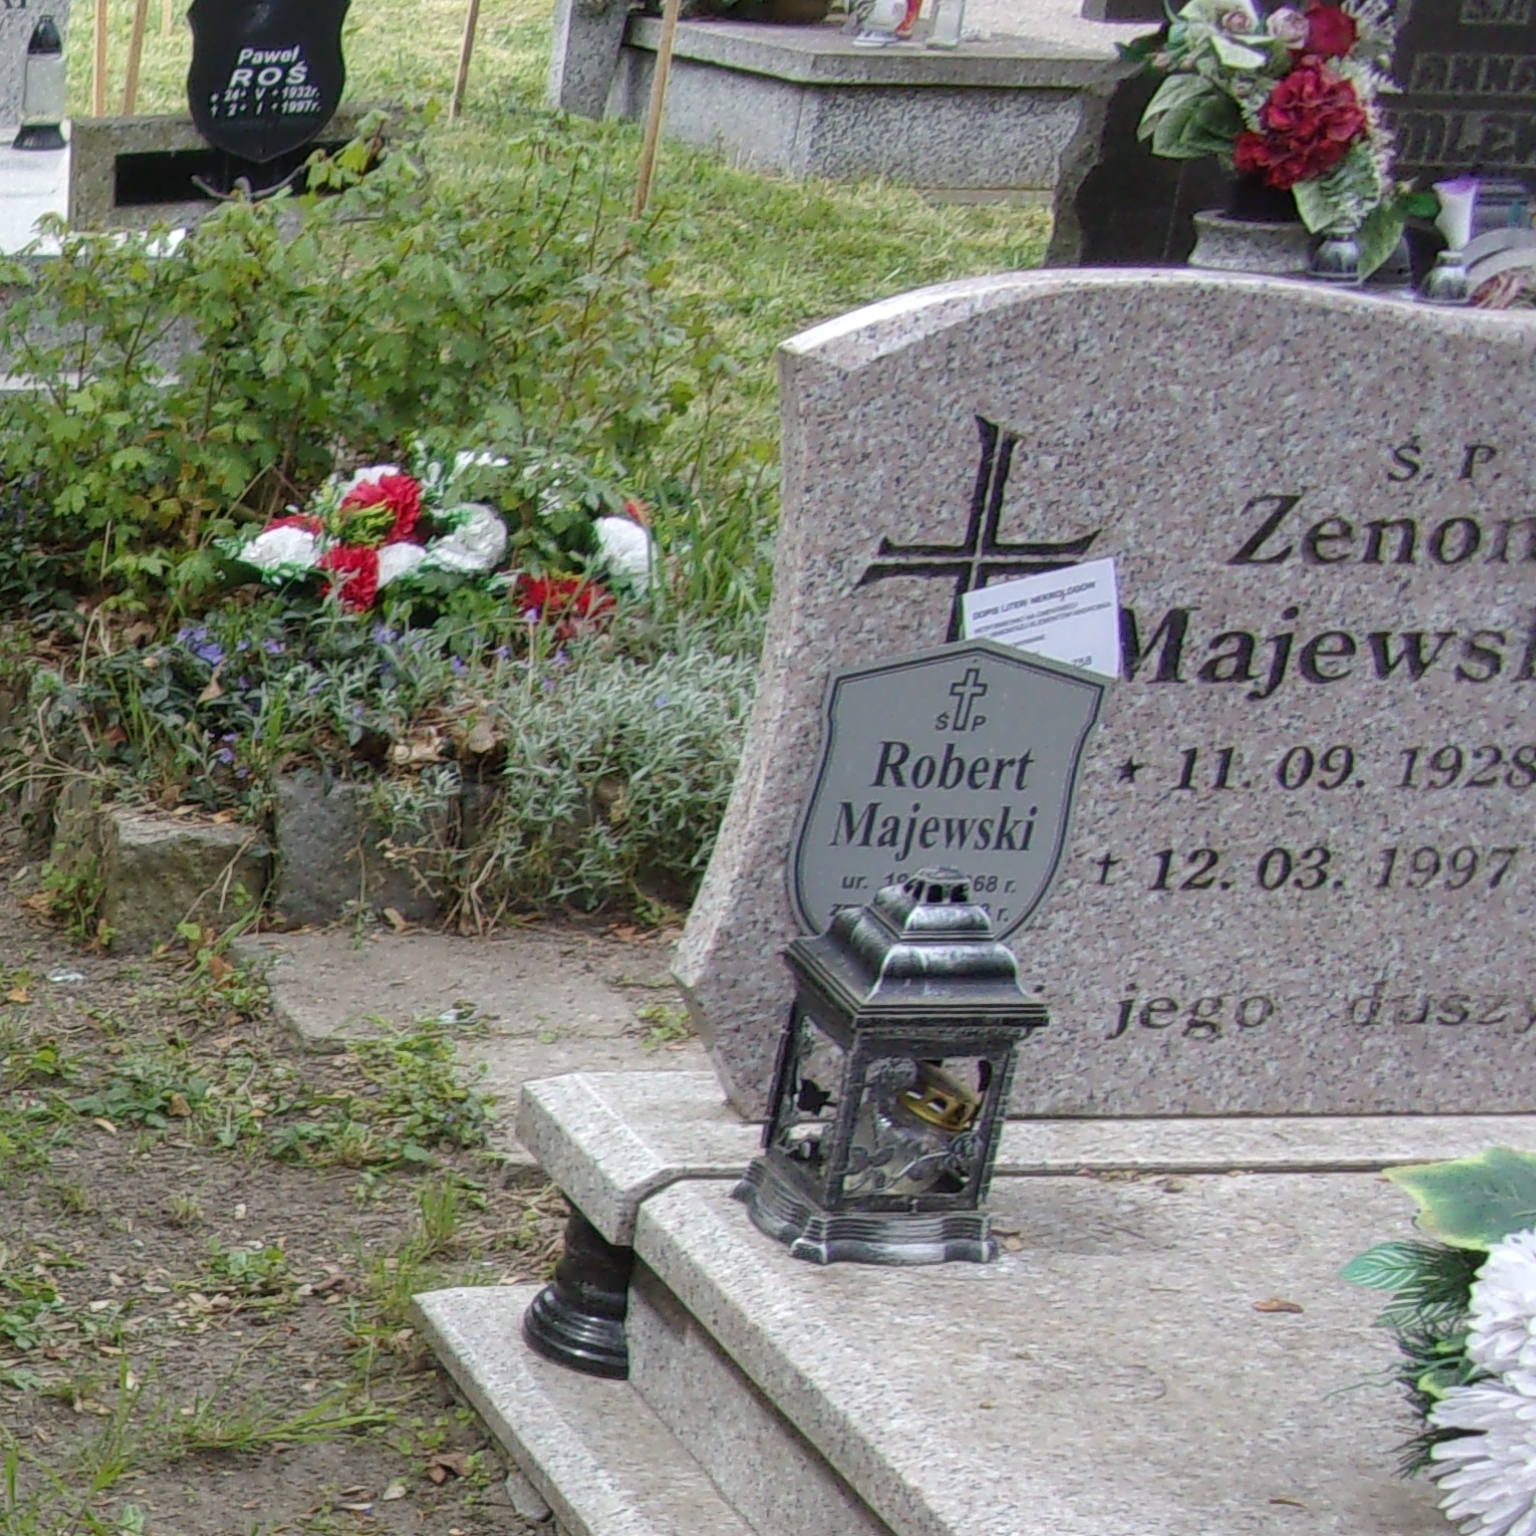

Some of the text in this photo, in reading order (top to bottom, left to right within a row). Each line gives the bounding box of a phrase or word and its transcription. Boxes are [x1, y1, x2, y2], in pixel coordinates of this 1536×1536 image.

[228, 60, 308, 88] ROŚ
[870, 740, 1035, 790] Robert
[1171, 744, 1536, 791] 11. 09. 1928
[829, 801, 1038, 862] Majewski
[842, 875, 869, 890] ur.
[1147, 845, 1520, 892] 12. 03. 1997
[1105, 981, 1275, 1041] jego
